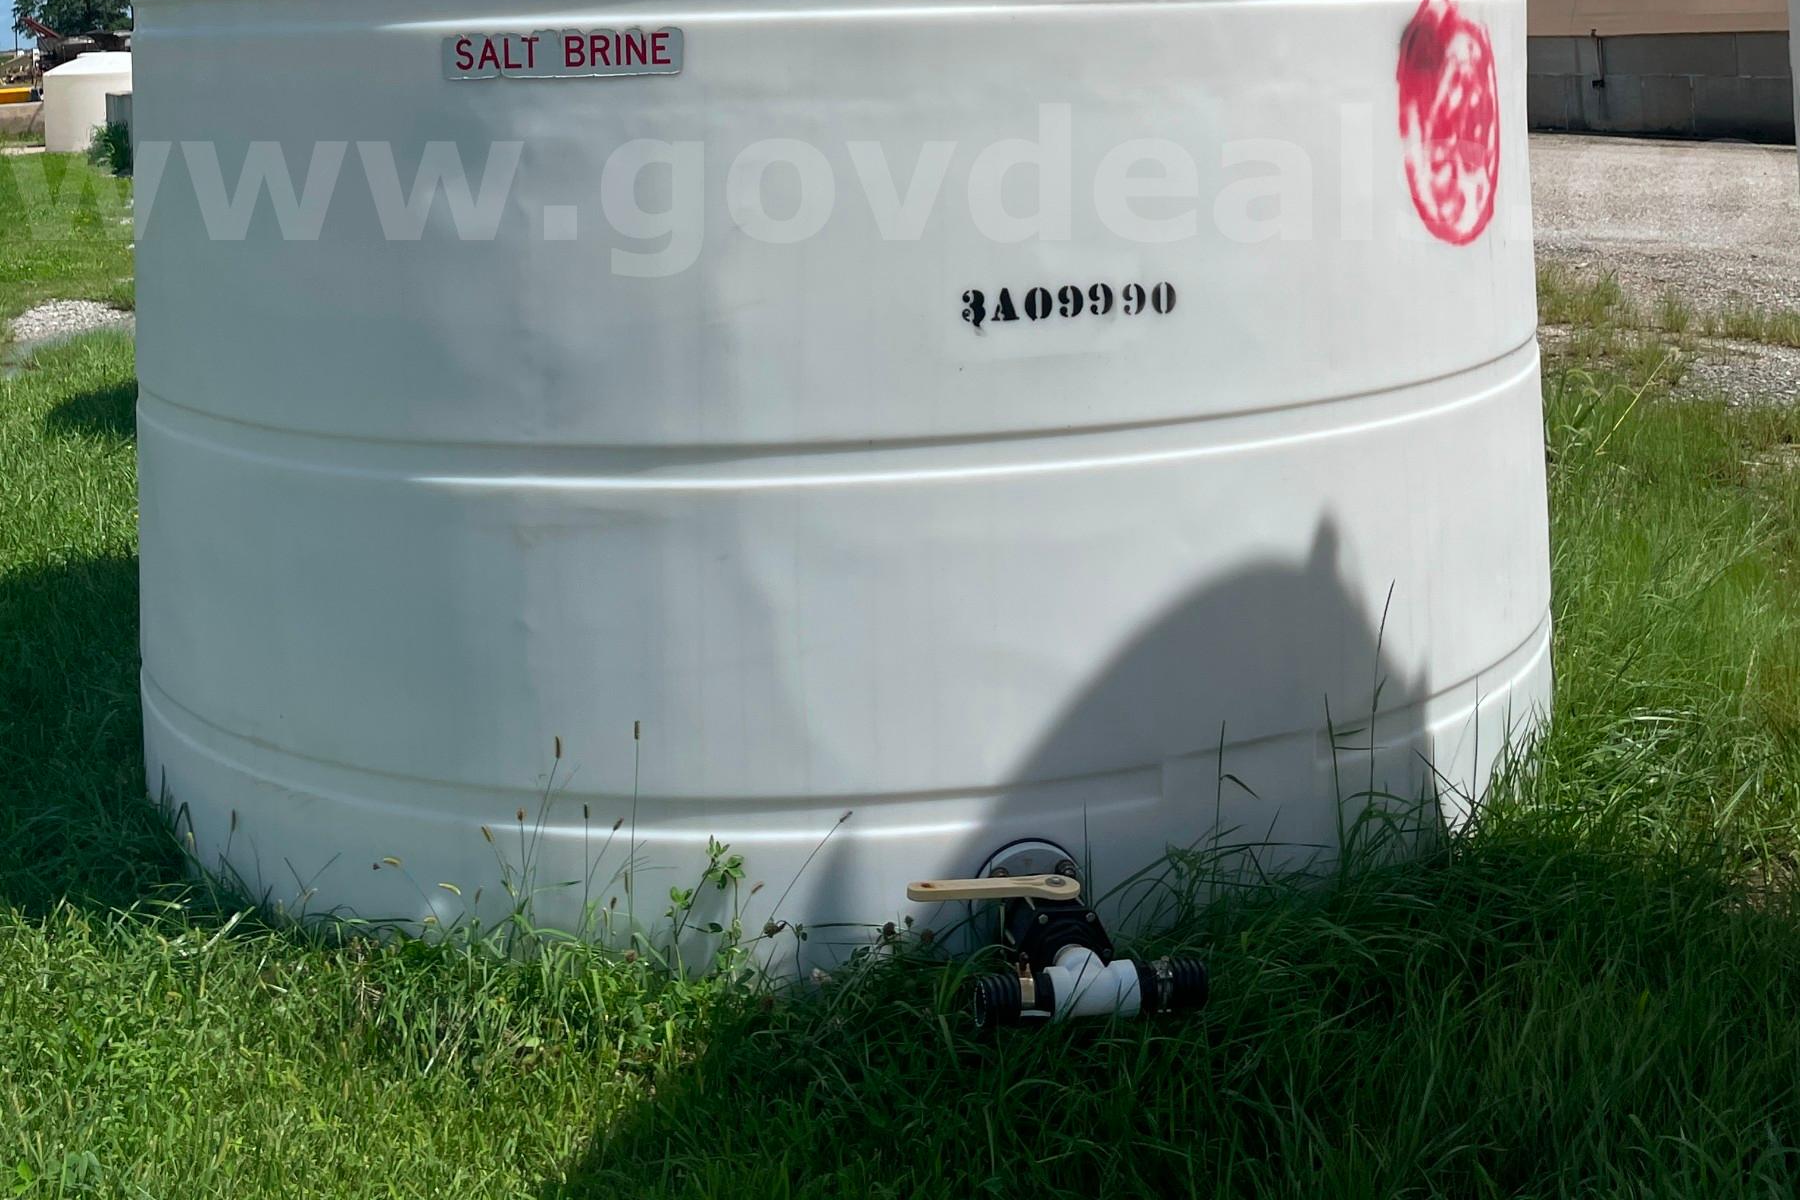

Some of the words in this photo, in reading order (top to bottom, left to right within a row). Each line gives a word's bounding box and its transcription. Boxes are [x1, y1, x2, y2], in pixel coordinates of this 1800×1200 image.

[455, 36, 540, 71] SALT
[564, 32, 672, 68] BRINE
[962, 281, 1177, 325] 3A09990
